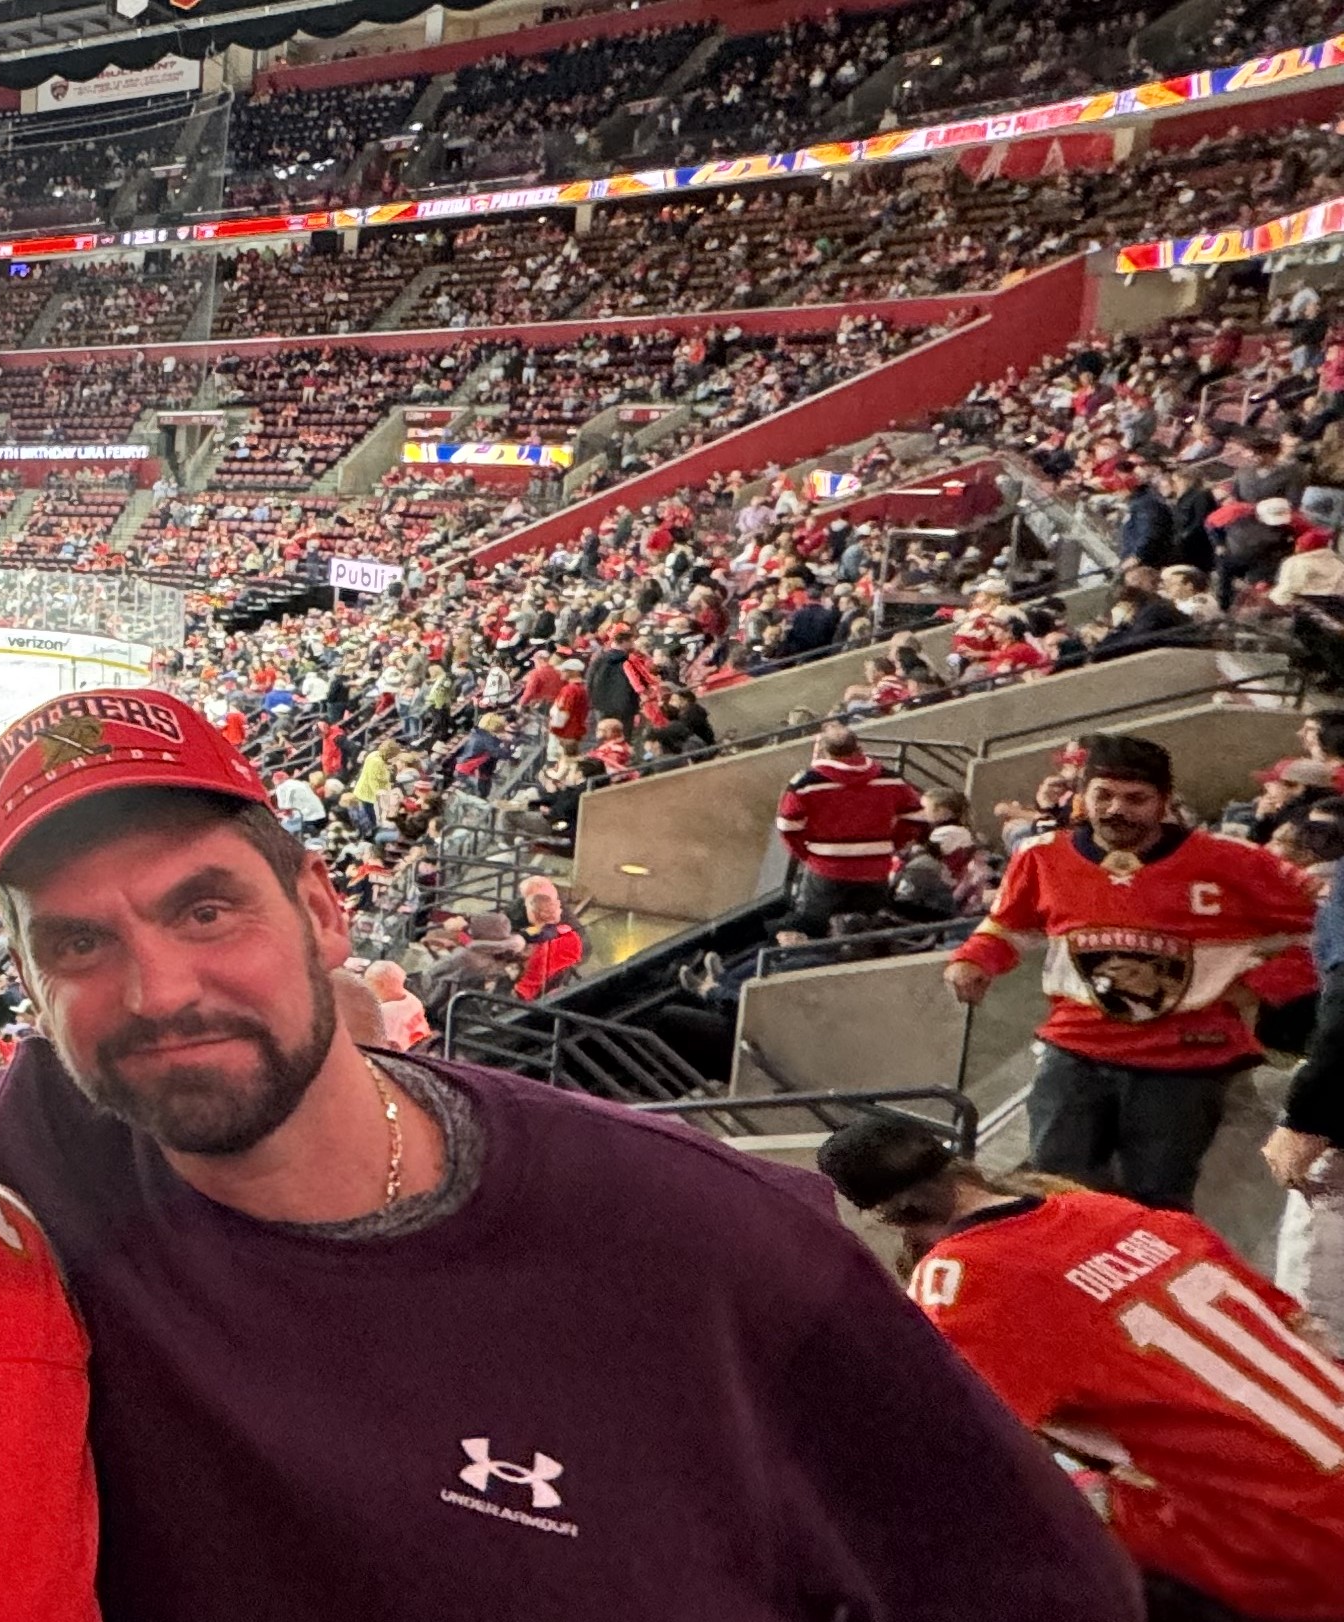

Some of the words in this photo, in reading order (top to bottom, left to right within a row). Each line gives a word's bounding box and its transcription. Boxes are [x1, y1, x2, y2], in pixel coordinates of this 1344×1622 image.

[417, 196, 471, 218] FLORIDA
[489, 186, 559, 210] PANTHERS
[20, 446, 77, 459] BIRTHDAY
[8, 635, 64, 651] verizon
[1190, 880, 1222, 916] C
[1117, 1261, 1344, 1473] 10
